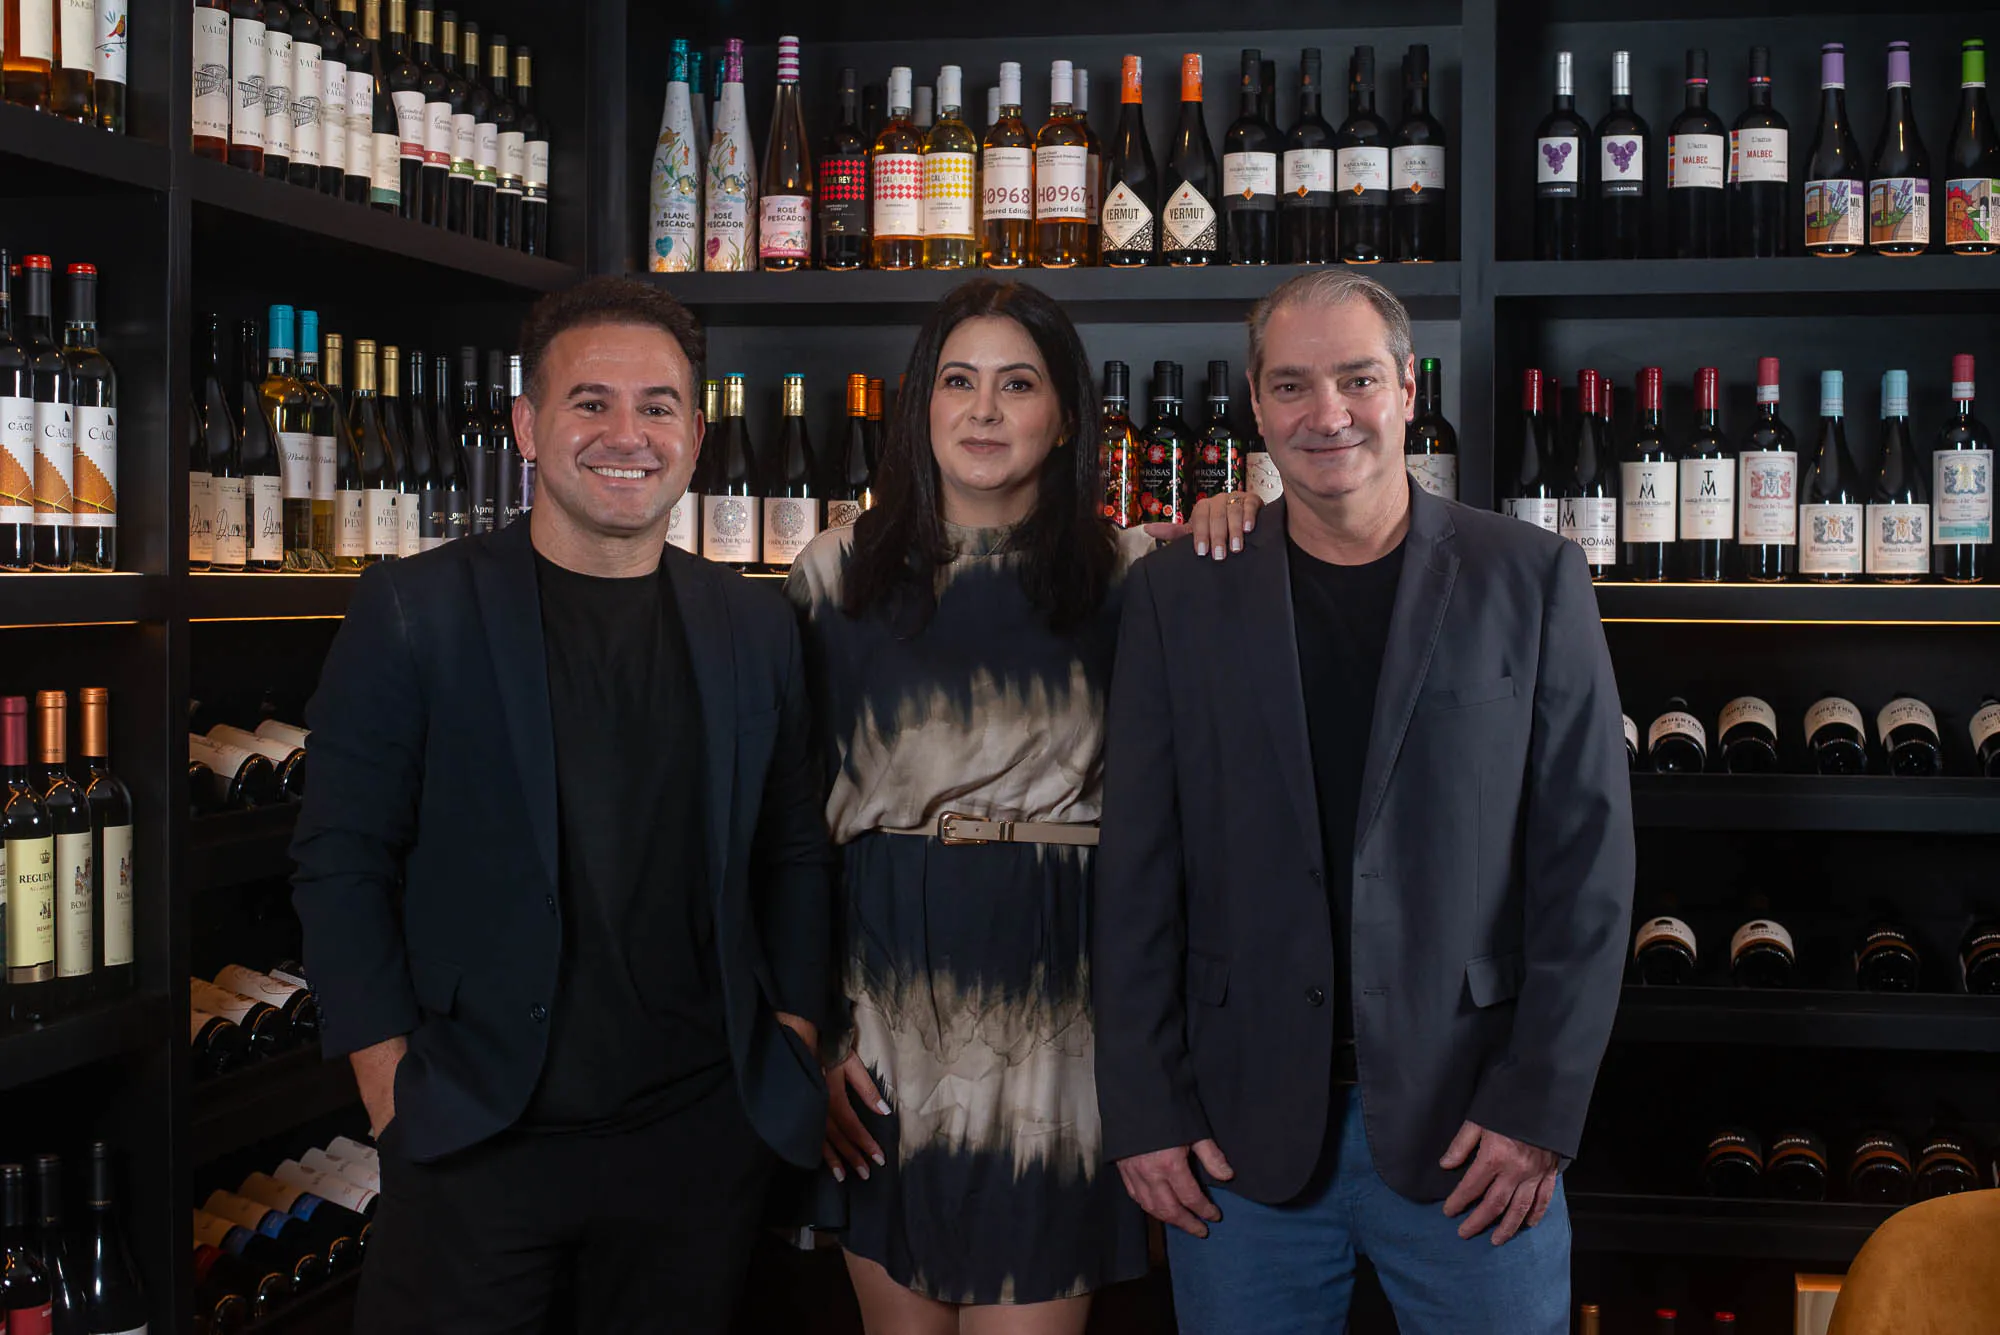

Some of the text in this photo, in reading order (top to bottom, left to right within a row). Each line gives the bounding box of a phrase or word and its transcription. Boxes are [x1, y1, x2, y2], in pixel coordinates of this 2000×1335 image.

[1746, 149, 1773, 158] MALBEC
[1682, 156, 1708, 165] MALBEC
[838, 175, 852, 184] REY
[1850, 197, 1860, 207] MIL
[1915, 196, 1926, 206] MIL
[663, 212, 689, 220] BLANC
[713, 211, 732, 219] ROSÉ
[1169, 208, 1204, 220] VERMUT
[657, 220, 695, 228] PESCADOR
[706, 220, 744, 228] PESCADOR
[1144, 468, 1171, 476] ROSAS
[1581, 536, 1614, 546] ROMÁN
